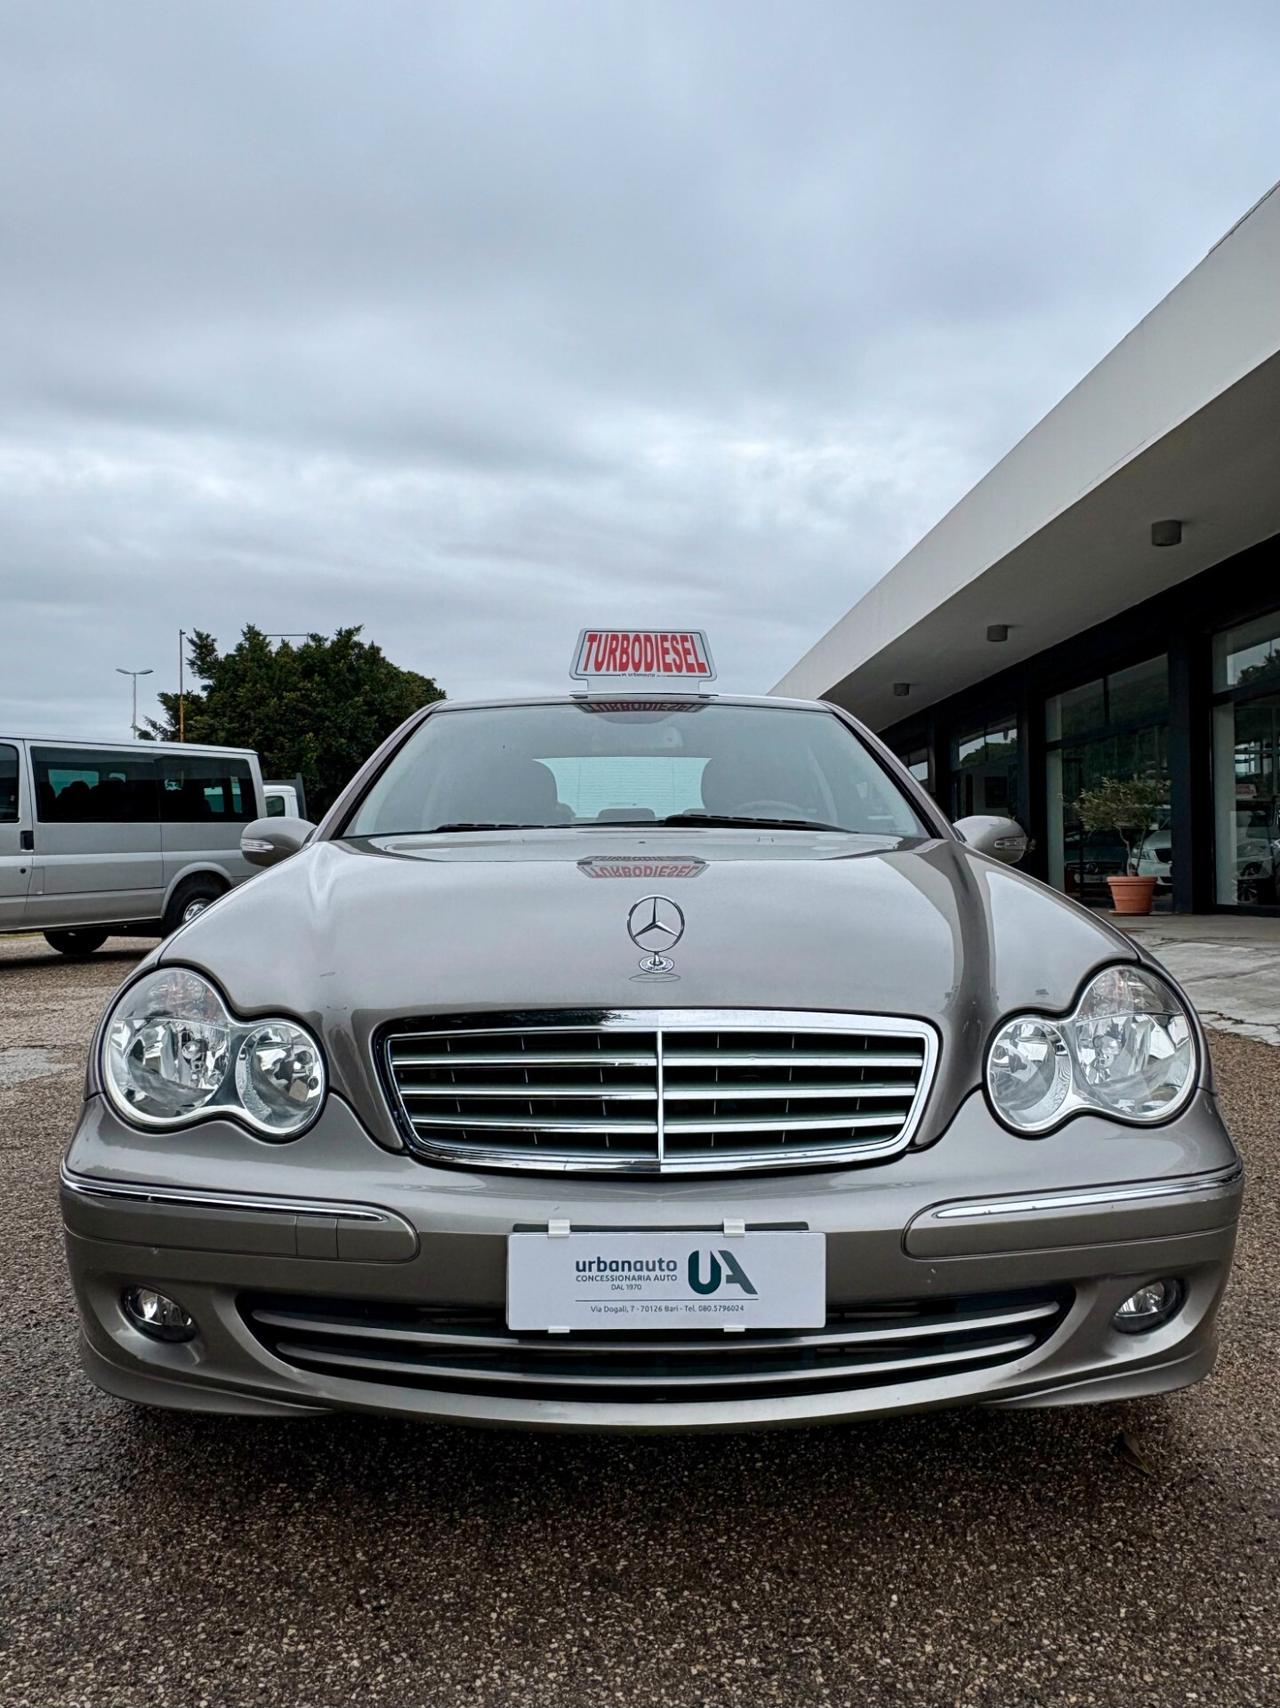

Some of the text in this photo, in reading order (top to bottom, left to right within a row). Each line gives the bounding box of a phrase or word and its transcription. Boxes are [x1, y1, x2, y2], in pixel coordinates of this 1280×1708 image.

[583, 633, 708, 673] TURBODIESEL
[575, 1256, 678, 1273] urbanauto
[688, 1250, 758, 1295] UA
[575, 1274, 678, 1282] CONCESSIONARIA AUTO
[590, 1305, 603, 1313] Via
[603, 1305, 629, 1314] Dogali,
[640, 1305, 663, 1313] 70126
[664, 1305, 679, 1313] Bari
